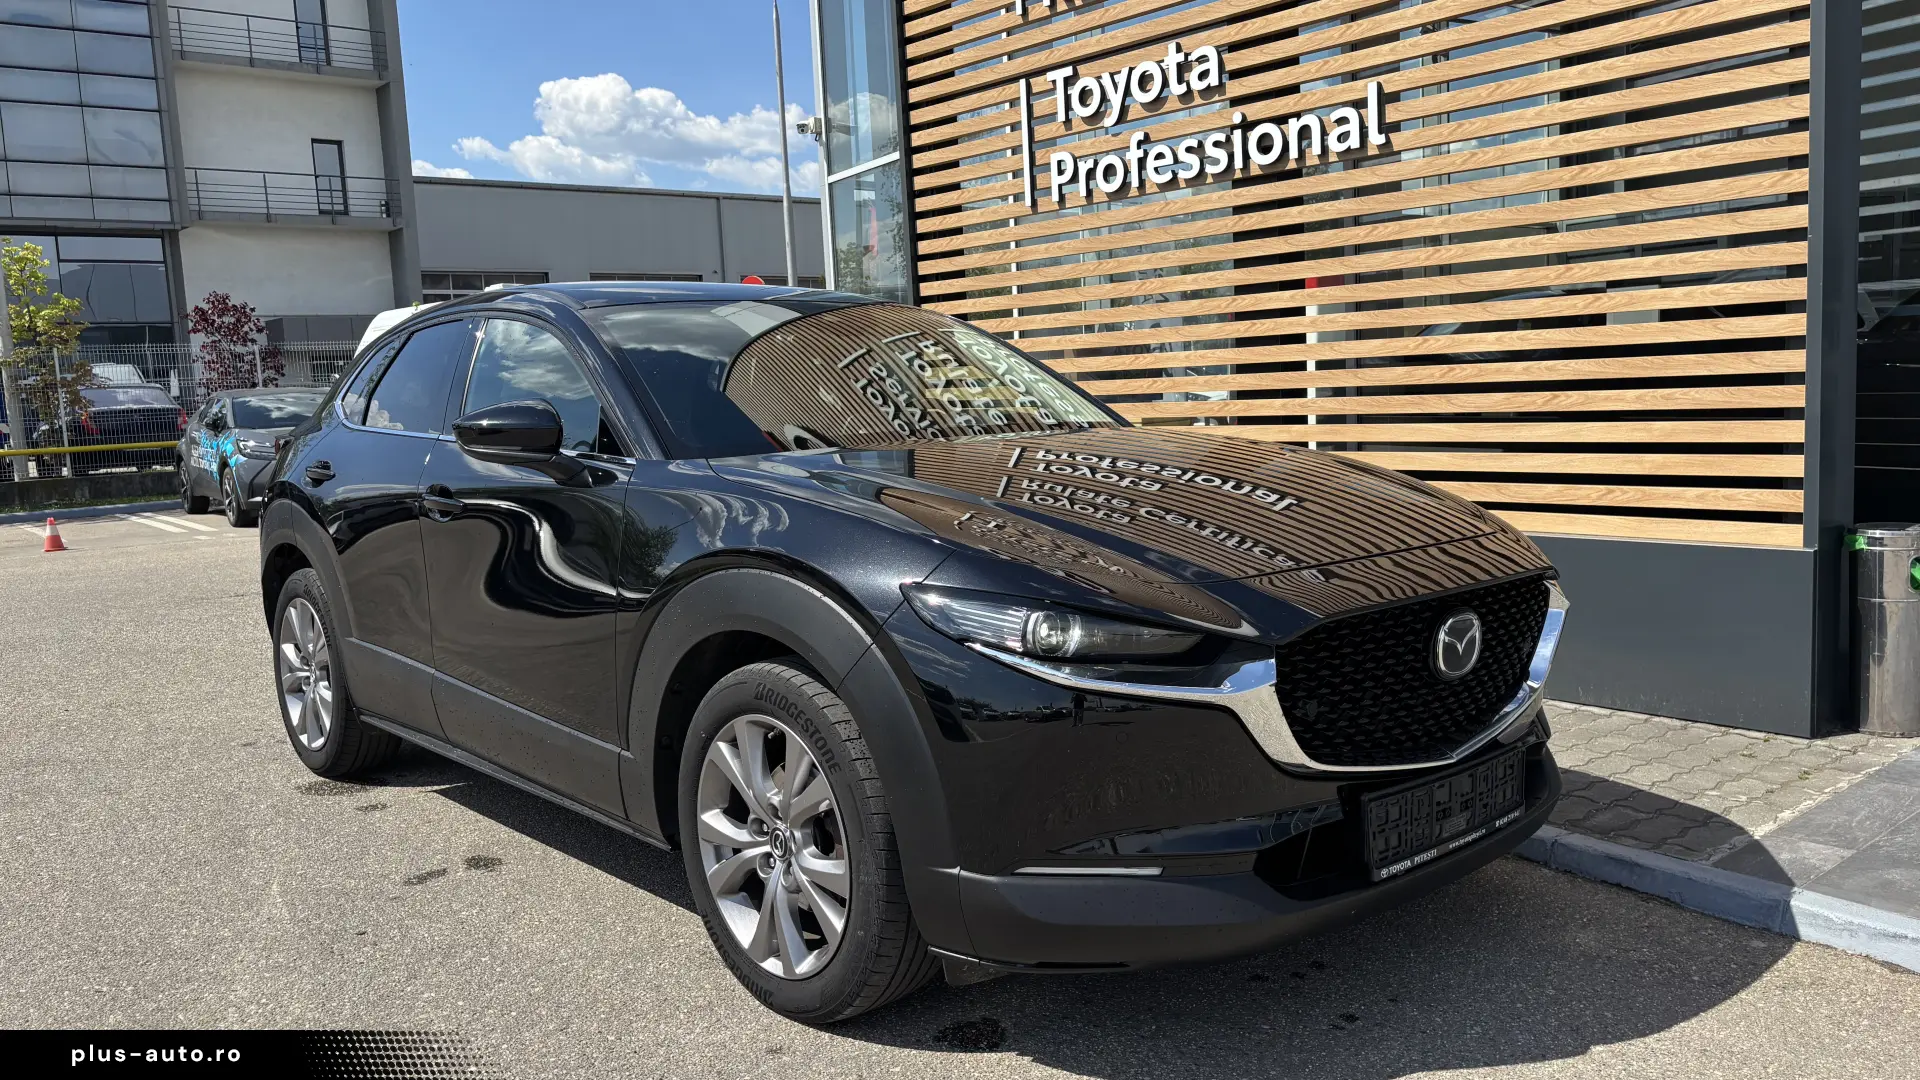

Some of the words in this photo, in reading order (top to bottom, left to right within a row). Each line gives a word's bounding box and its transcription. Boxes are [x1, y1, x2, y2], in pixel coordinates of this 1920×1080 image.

[1046, 41, 1223, 127] Toyota
[1050, 81, 1386, 202] Professional
[754, 682, 842, 775] BRIDGESTONE
[1388, 860, 1412, 875] TOYOTA
